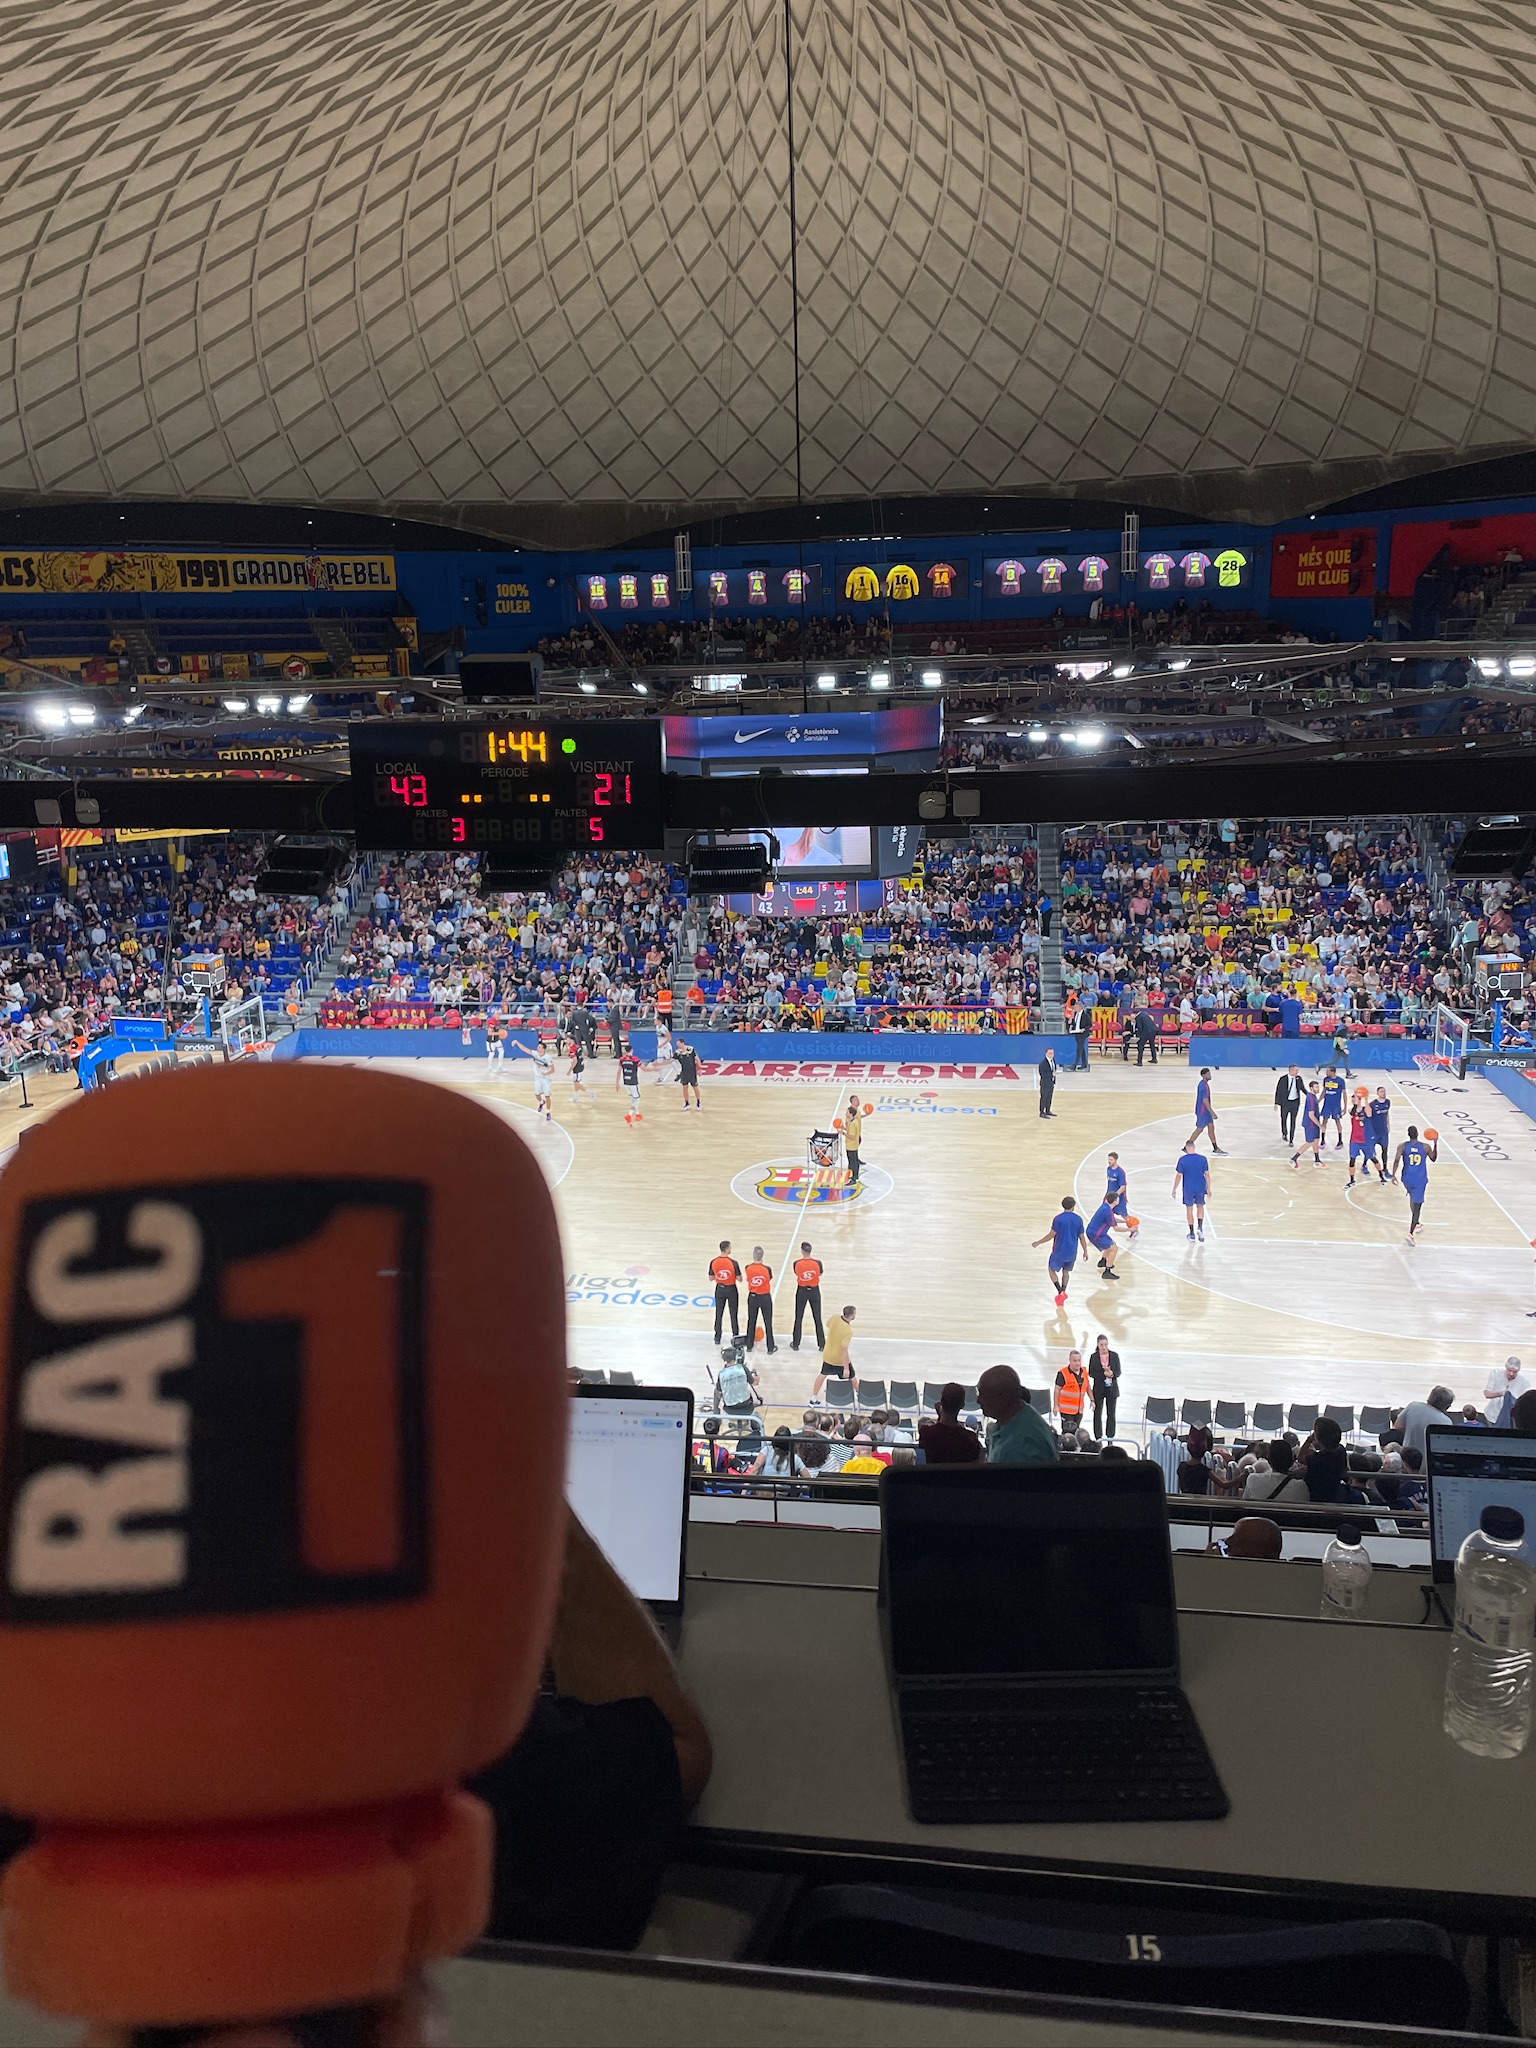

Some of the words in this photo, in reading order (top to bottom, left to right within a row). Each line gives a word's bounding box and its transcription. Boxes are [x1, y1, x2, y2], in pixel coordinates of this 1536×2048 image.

[1298, 545, 1323, 567] MÉS
[1325, 549, 1352, 568] QUE
[1089, 566, 1097, 577] 5
[1155, 563, 1164, 574] 4
[1191, 562, 1199, 573] 2
[1222, 560, 1238, 571] 28
[0, 557, 36, 587] CS
[176, 559, 230, 587] 1991
[232, 559, 307, 587] GRADA
[328, 560, 391, 586] REBEL
[934, 572, 949, 584] 14
[1006, 569, 1015, 580] 8
[1048, 567, 1056, 579] 7
[1297, 570, 1316, 586] UN
[1318, 569, 1350, 585] CLUB
[753, 579, 762, 590] 4
[789, 578, 802, 589] 21
[860, 576, 865, 586] 1
[895, 575, 909, 585] 16
[496, 584, 529, 597] 100%
[590, 585, 604, 596] 15
[621, 584, 635, 595] 12
[653, 583, 666, 594] 11
[495, 600, 531, 613] CULER
[803, 728, 839, 736] Assistència
[803, 734, 829, 742] Sanitària
[488, 731, 547, 763] 1:44
[375, 762, 421, 775] LOCAL
[480, 767, 529, 778] PERIODE
[570, 760, 634, 773] VISITANT
[390, 775, 428, 806] 43
[594, 773, 632, 806] 21
[415, 809, 448, 818] FALTES
[555, 808, 588, 817] FALTES
[451, 818, 465, 842] 3
[589, 817, 604, 841] 5
[795, 886, 813, 895] 1:44
[758, 902, 773, 914] 43
[834, 900, 848, 913] 21
[124, 1024, 153, 1033] endesa
[184, 1043, 215, 1051] endesa
[1486, 1058, 1527, 1068] endesa
[699, 1062, 1020, 1080] BARCELONA
[1398, 1080, 1449, 1094] acb
[879, 1096, 932, 1106] liga
[876, 1104, 997, 1115] endesa
[1443, 1110, 1513, 1161] endesa
[1408, 1154, 1421, 1166] 19
[565, 1273, 638, 1290] liga
[565, 1290, 716, 1308] endesa
[7, 1197, 205, 1596] RAC
[223, 1206, 400, 1576] 1
[1126, 1934, 1162, 1962] 15
